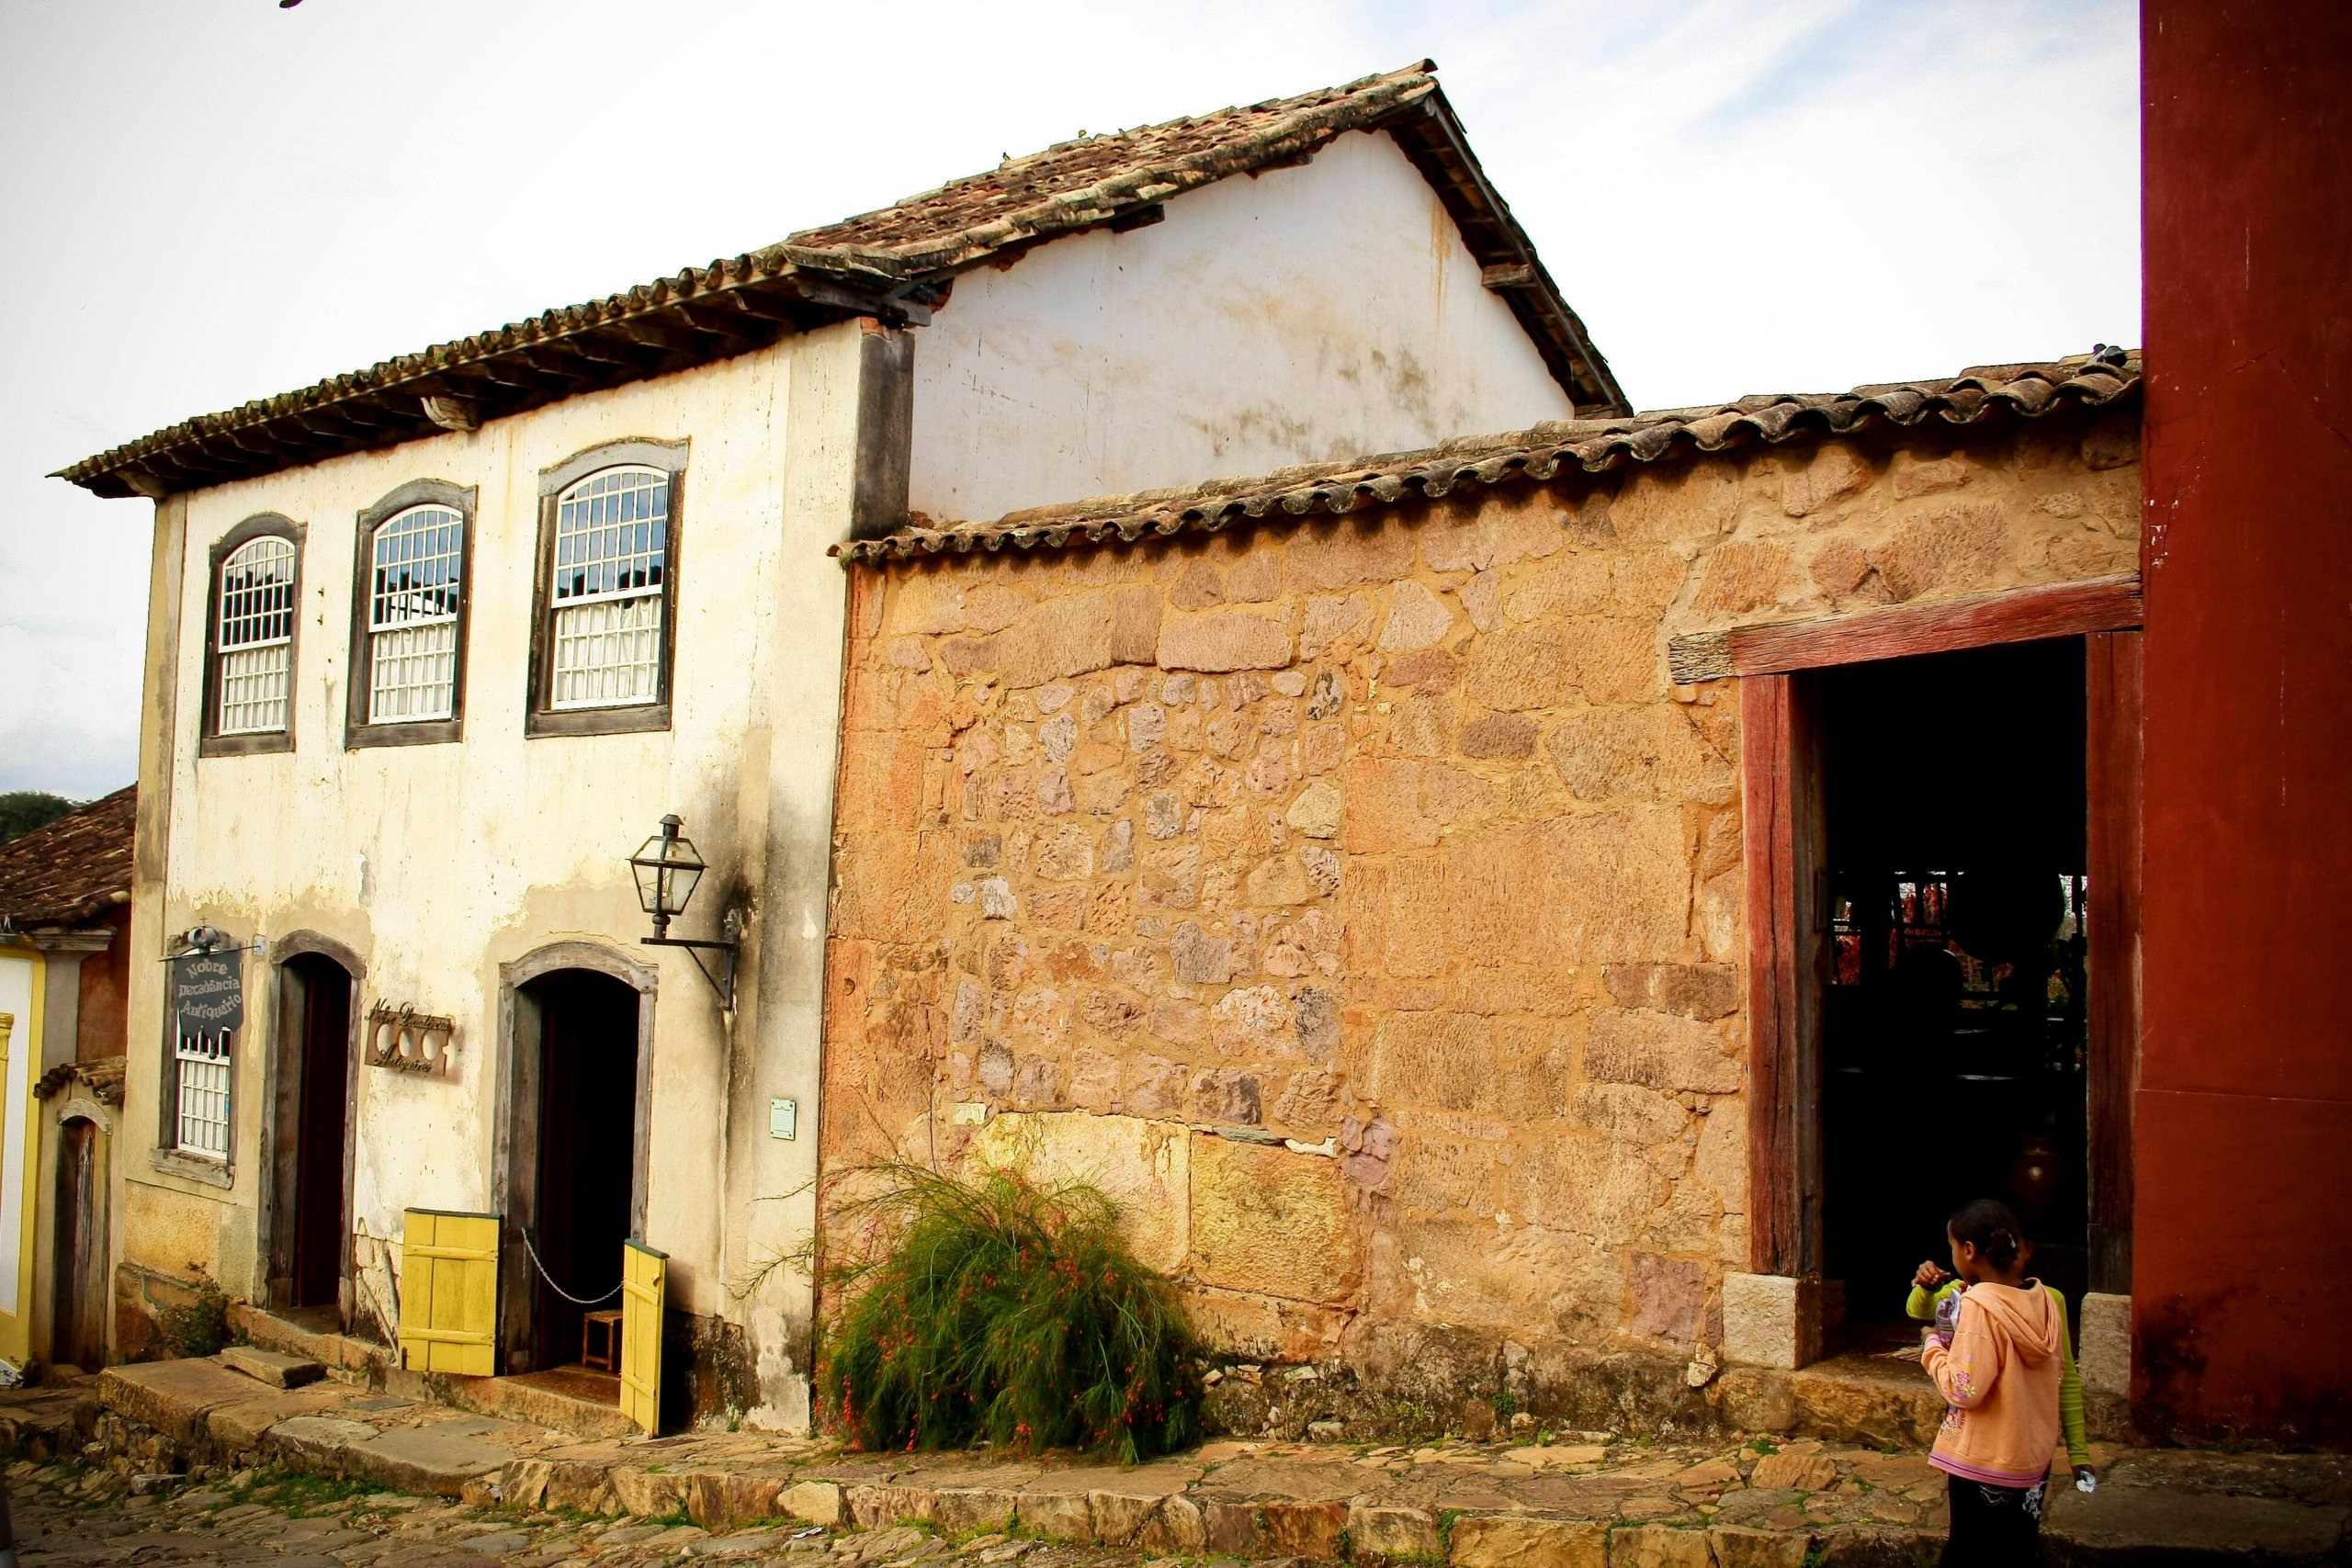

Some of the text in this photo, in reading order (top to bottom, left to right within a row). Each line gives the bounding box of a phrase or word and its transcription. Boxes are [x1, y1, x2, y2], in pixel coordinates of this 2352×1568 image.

[186, 958, 228, 979] Nobre
[178, 976, 241, 998] Decadência
[180, 994, 242, 1021] Antiquário
